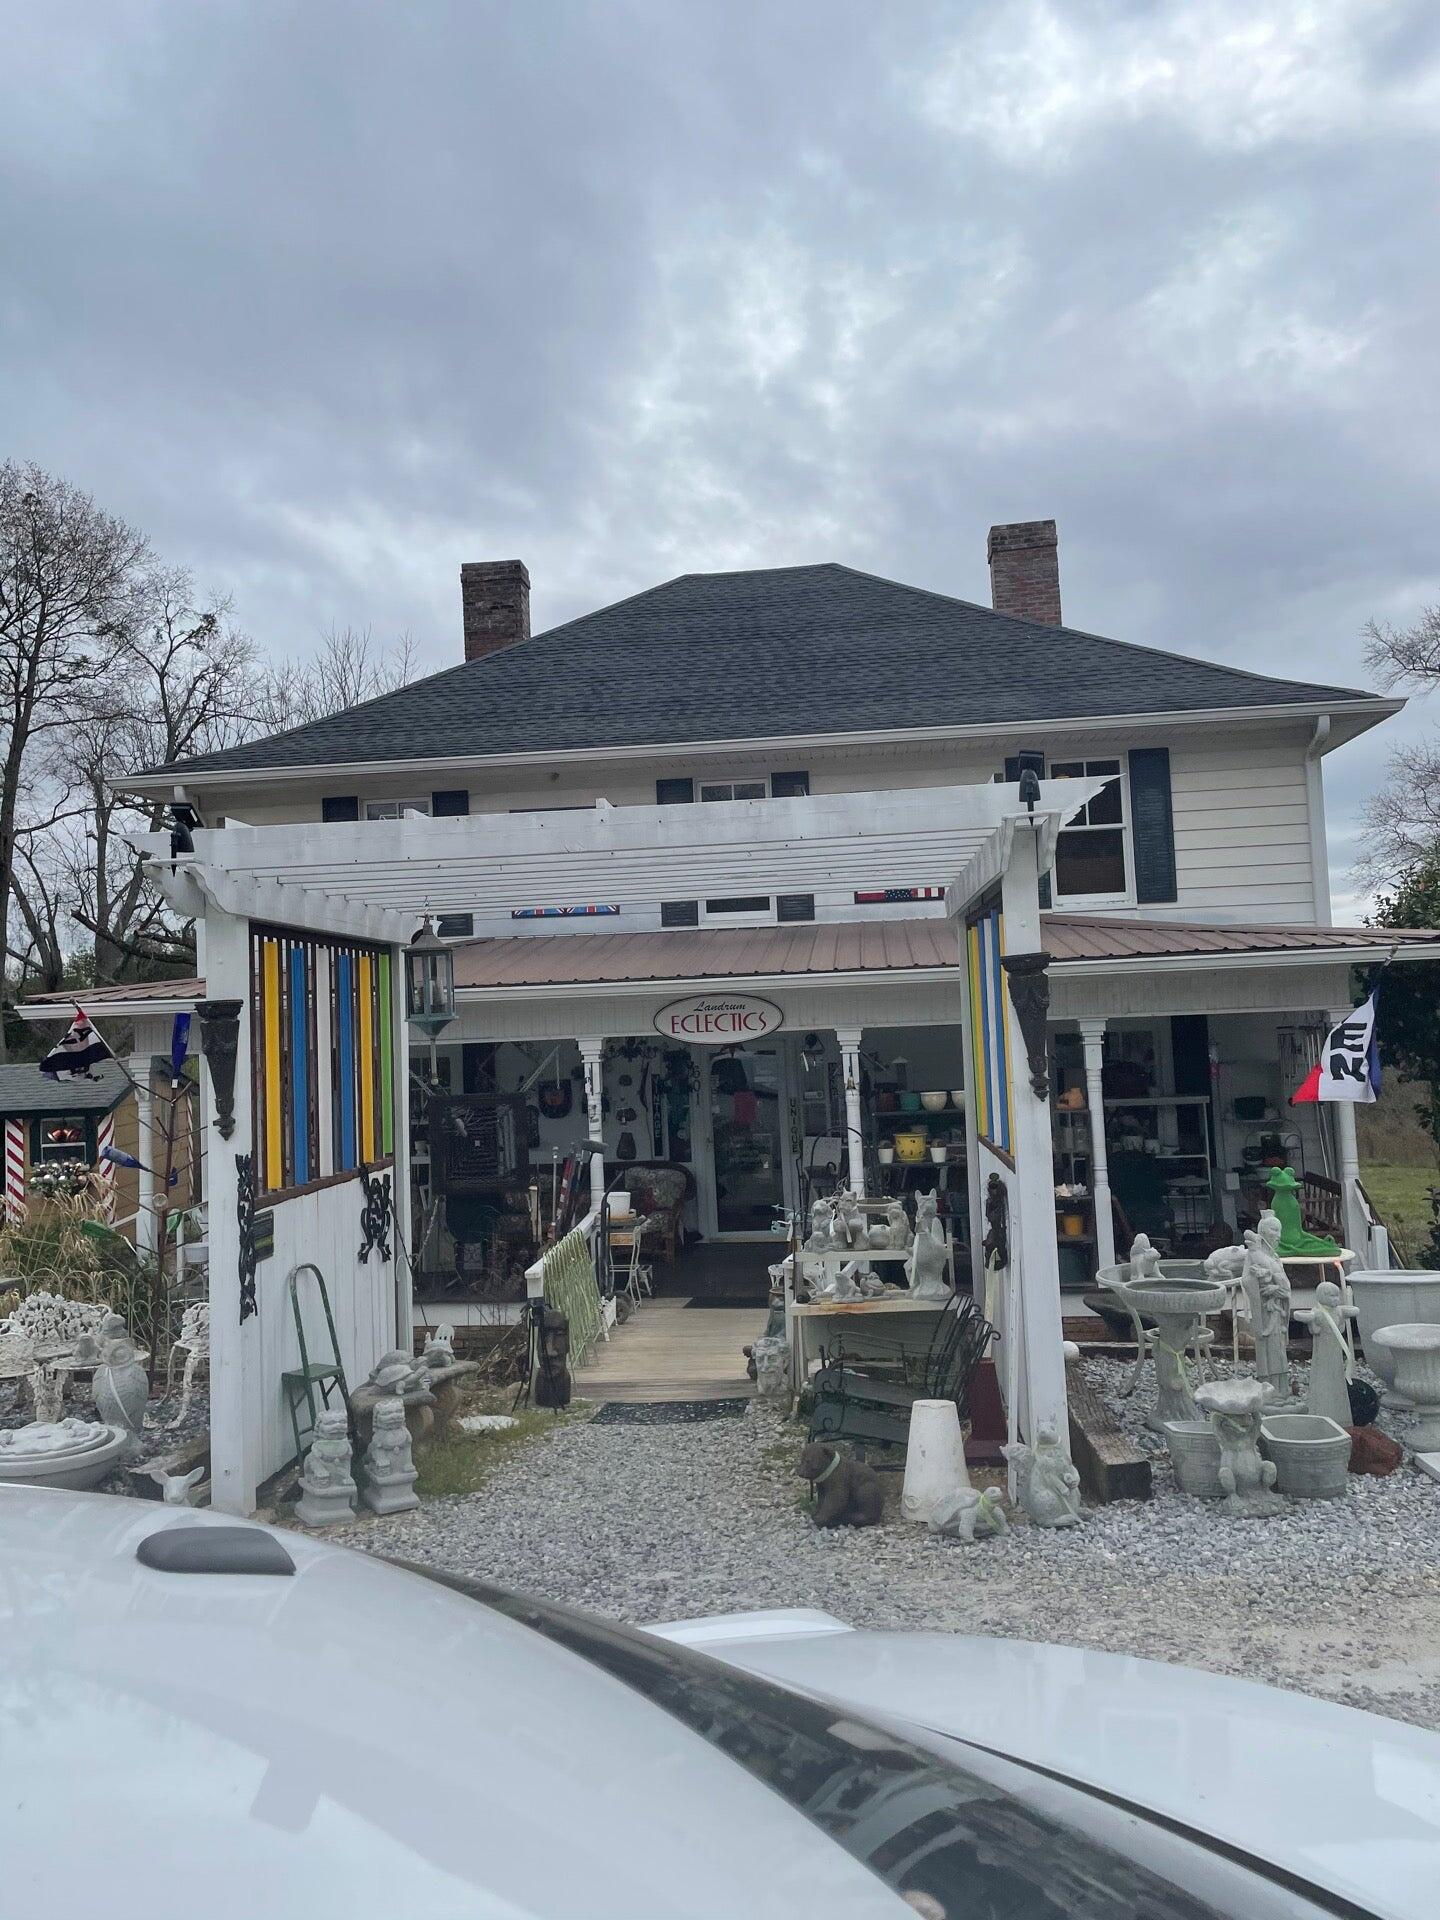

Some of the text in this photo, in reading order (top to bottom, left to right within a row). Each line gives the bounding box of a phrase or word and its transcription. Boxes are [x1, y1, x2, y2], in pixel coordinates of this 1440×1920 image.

[671, 1011, 767, 1034] ECLECTICS
[693, 1001, 746, 1012] Landrum
[1330, 1022, 1368, 1083] EN
[789, 1098, 799, 1154] UNIQUE
